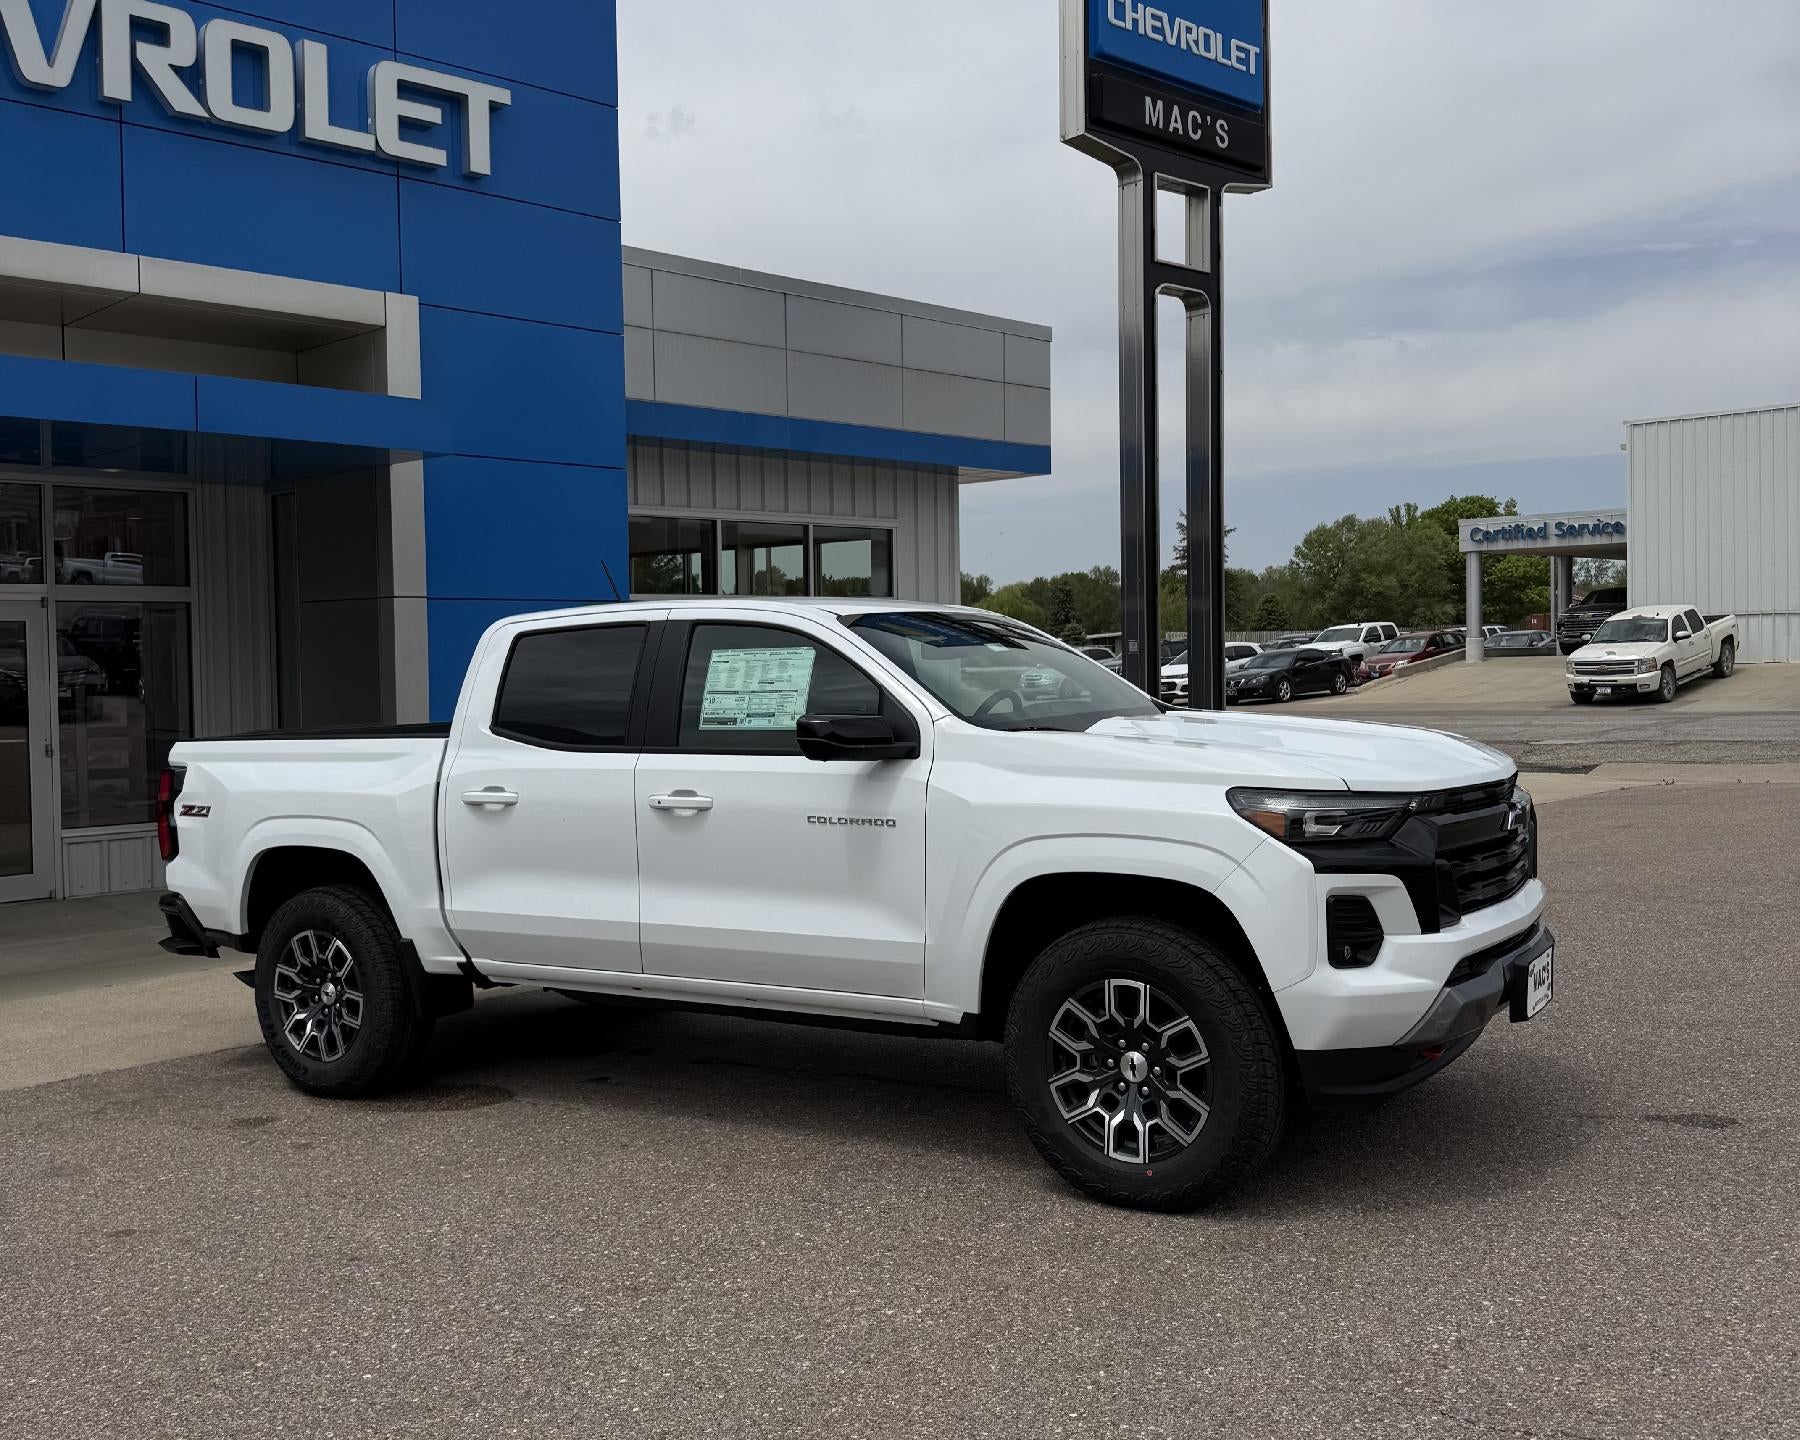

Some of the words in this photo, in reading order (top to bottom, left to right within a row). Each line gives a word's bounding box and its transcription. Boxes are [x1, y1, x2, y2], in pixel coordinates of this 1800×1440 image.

[1107, 0, 1260, 76] CHEVROLET
[1144, 95, 1230, 149] MAC'S
[1469, 522, 1548, 543] Certified
[1554, 518, 1626, 538] Service
[807, 815, 897, 828] COLORADO
